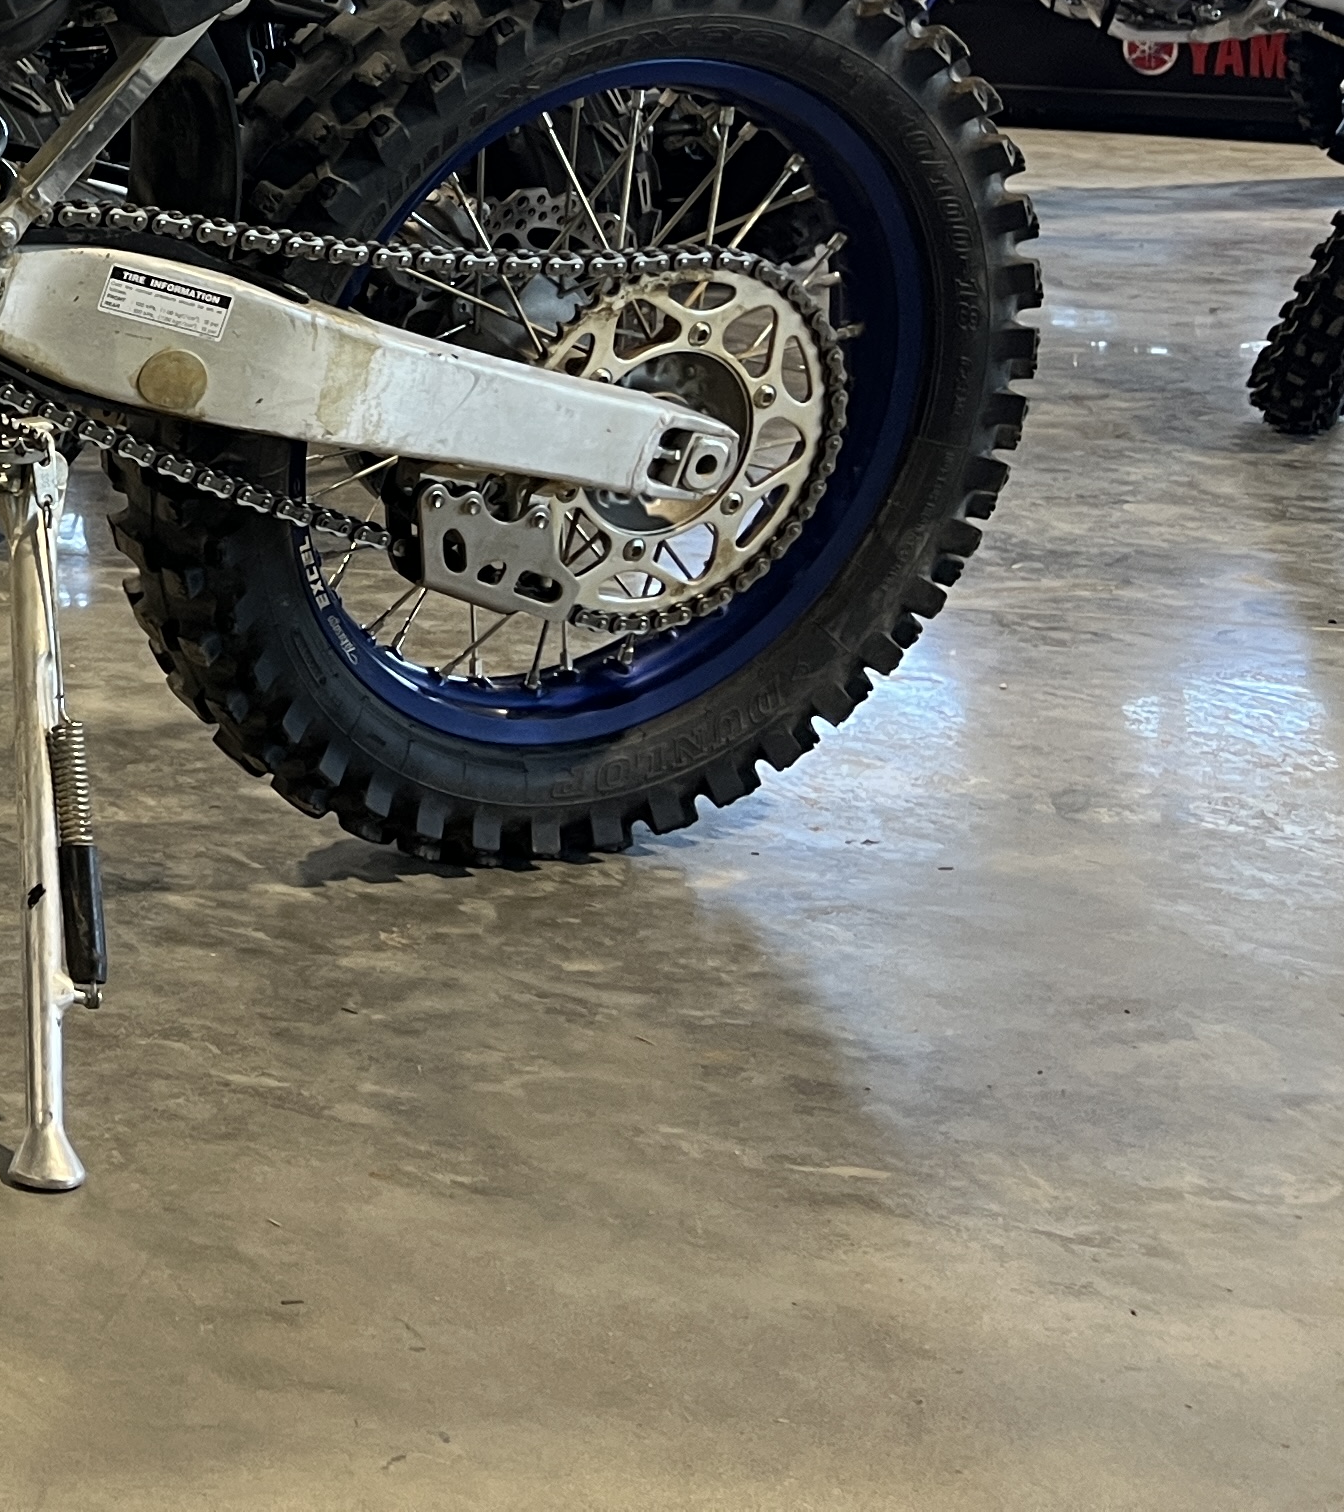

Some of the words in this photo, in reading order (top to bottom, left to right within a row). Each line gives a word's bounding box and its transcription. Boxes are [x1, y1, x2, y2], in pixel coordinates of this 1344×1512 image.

[122, 271, 146, 285] TIRE
[150, 278, 221, 304] INFORMATION
[298, 535, 332, 613] EXCEL
